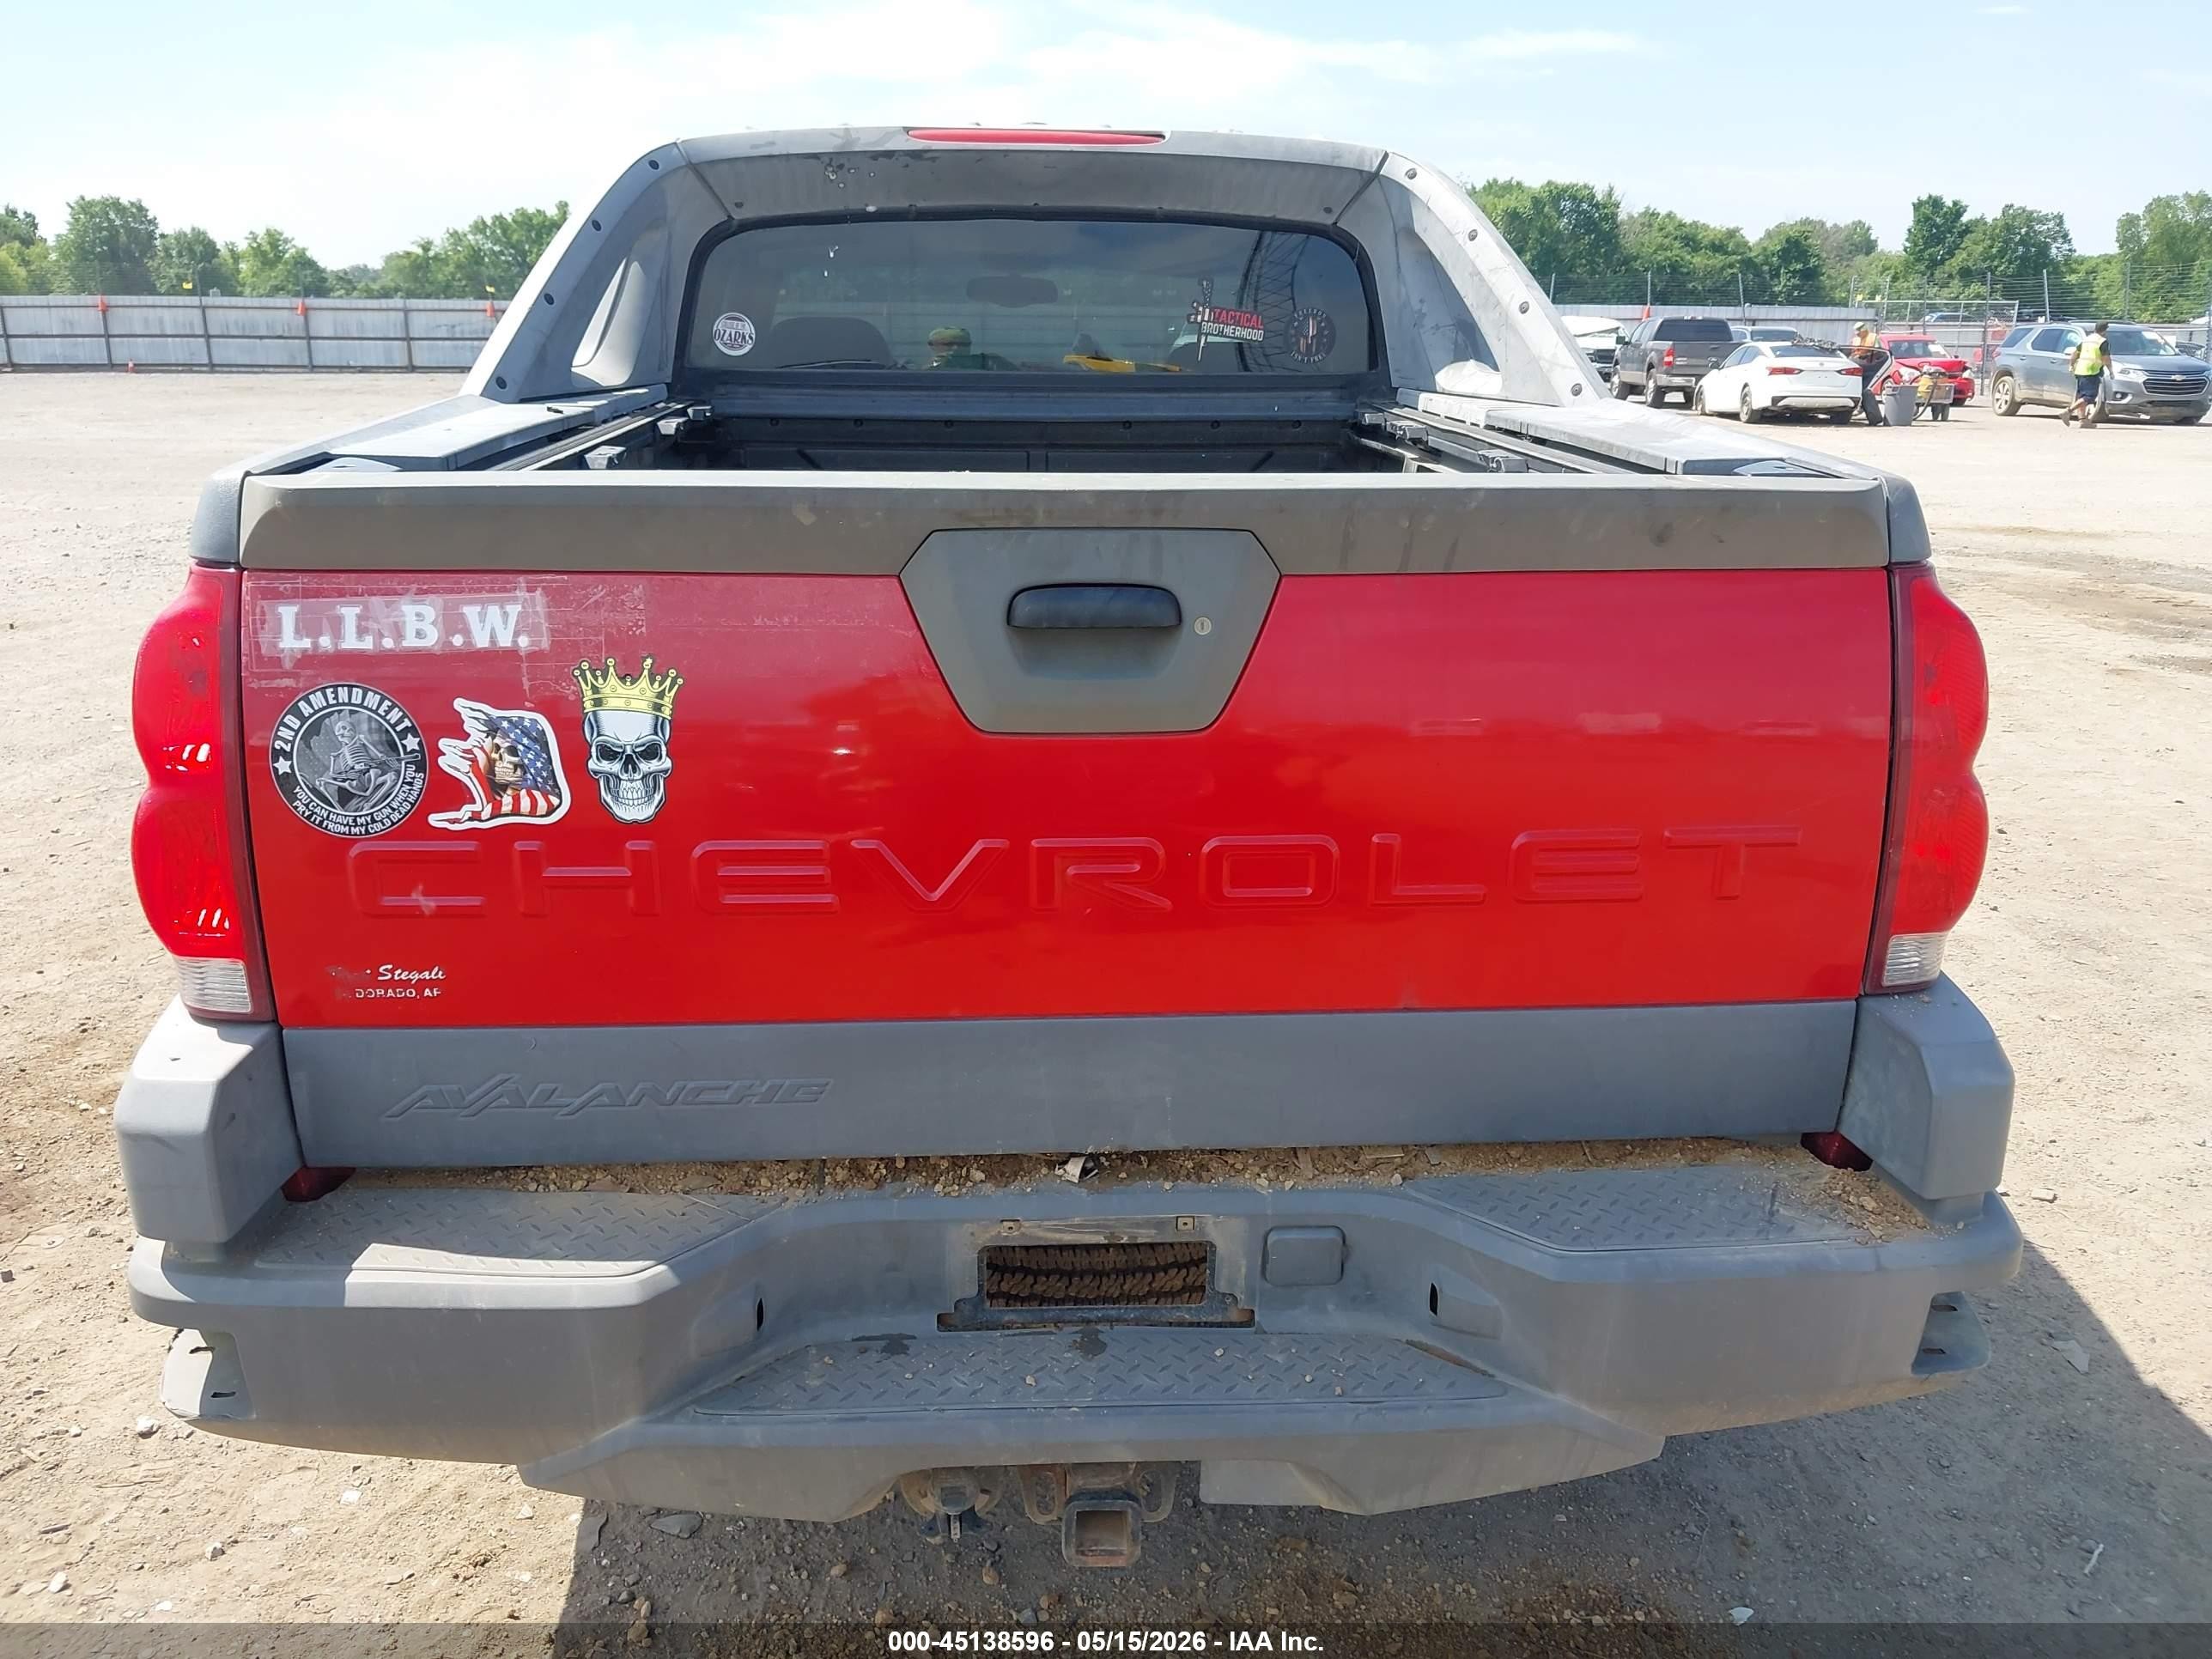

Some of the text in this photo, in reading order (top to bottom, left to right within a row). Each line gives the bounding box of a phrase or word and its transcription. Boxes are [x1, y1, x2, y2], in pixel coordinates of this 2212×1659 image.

[714, 328, 754, 345] OZARKS
[1200, 322, 1264, 342] BROTHERHOOD
[1213, 308, 1264, 329] TACTICAL
[274, 686, 412, 752] 2ND AMENDMENT
[292, 772, 425, 836] PRY IT FROM MY COLD DEAD HANDS
[293, 763, 416, 826] YOU CAN HAVE MY GUN WHEN YOU
[348, 825, 1802, 917] CHEVROLET
[384, 1073, 835, 1120] AVALANCHE
